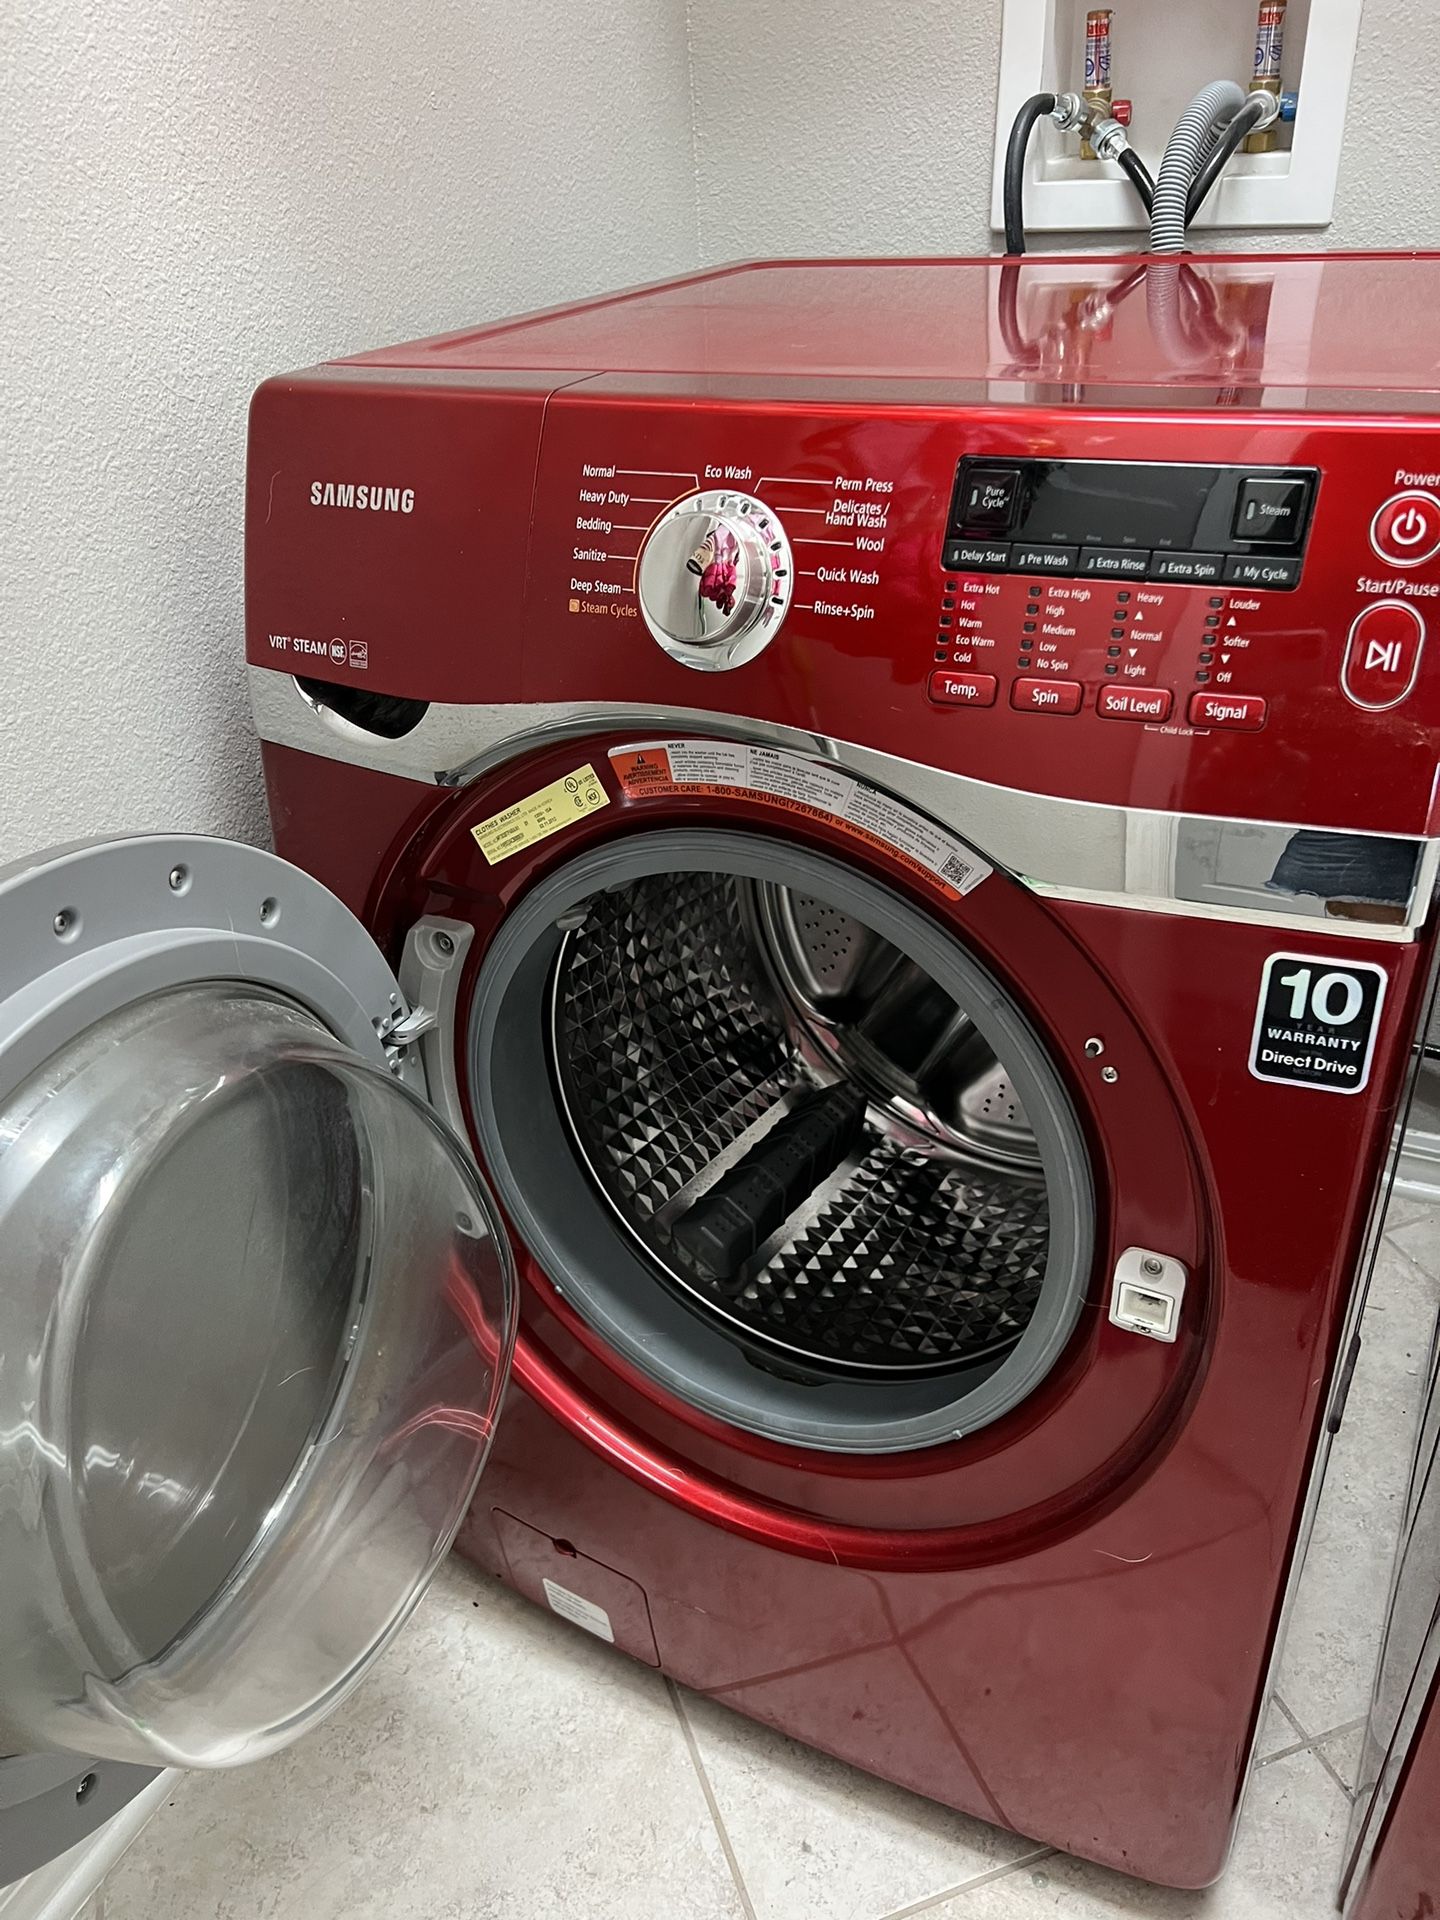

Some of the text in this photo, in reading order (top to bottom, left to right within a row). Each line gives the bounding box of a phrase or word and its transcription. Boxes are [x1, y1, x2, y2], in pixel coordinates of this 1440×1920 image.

[582, 464, 616, 478] Normal
[704, 464, 752, 480] Eco Wash
[1394, 469, 1440, 486] Power
[834, 476, 894, 493] Perm Press
[986, 485, 1004, 497] Pure
[310, 481, 416, 514] SAMSUNG
[579, 489, 630, 507] Heavy Duty
[832, 499, 882, 515] Delicates
[1259, 504, 1291, 516] Steam
[576, 516, 612, 534] Bedding
[825, 512, 888, 528] Hand Wash
[856, 536, 886, 552] Wool
[573, 547, 607, 562] Sanitize
[961, 550, 1007, 563] Delay Start
[1027, 554, 1069, 566] Pre Wash
[1096, 558, 1146, 572] Extra Rinse
[1168, 562, 1216, 577] Extra Spin
[816, 566, 880, 585] Quick Wash
[1243, 566, 1288, 580] My Cycle
[570, 578, 622, 594] Deep Steam
[963, 582, 1000, 595] Extra Hot
[1356, 577, 1439, 598] Start/Pause
[1048, 586, 1090, 601] Extra High
[1136, 592, 1164, 606] Heavy
[581, 600, 638, 618] Steam Cycles
[814, 600, 875, 620] Rinse+Spin
[960, 600, 976, 610] Hot
[1229, 598, 1260, 610] Louder
[1045, 605, 1065, 618] High
[958, 617, 983, 628] Warm
[1042, 624, 1076, 636] Medium
[1130, 630, 1163, 642] Normal
[293, 638, 328, 656] STEAM
[955, 634, 996, 648] Eco Warm
[1039, 641, 1058, 652] Low
[1223, 636, 1250, 648] Softer
[953, 652, 972, 662] Cold
[1036, 658, 1069, 672] No Spin
[1124, 664, 1146, 677] Light
[1216, 672, 1232, 683] Off
[944, 680, 980, 698] Temp.
[1031, 688, 1060, 705] Spin
[1105, 696, 1162, 714] Soil Level
[1205, 702, 1248, 721] Signal
[1160, 725, 1194, 737] Child Lock
[759, 750, 780, 760] JAMAIS
[630, 763, 659, 772] WARNING
[639, 786, 680, 796] CUSTOMER
[680, 786, 704, 794] CARE:
[475, 820, 498, 836] CLOTHES
[500, 807, 521, 823] WASHER
[1280, 968, 1364, 1026] 10
[1296, 1023, 1336, 1034] YEAR
[1267, 1027, 1362, 1052] WARRANTY
[1260, 1049, 1358, 1076] Direct Drive
